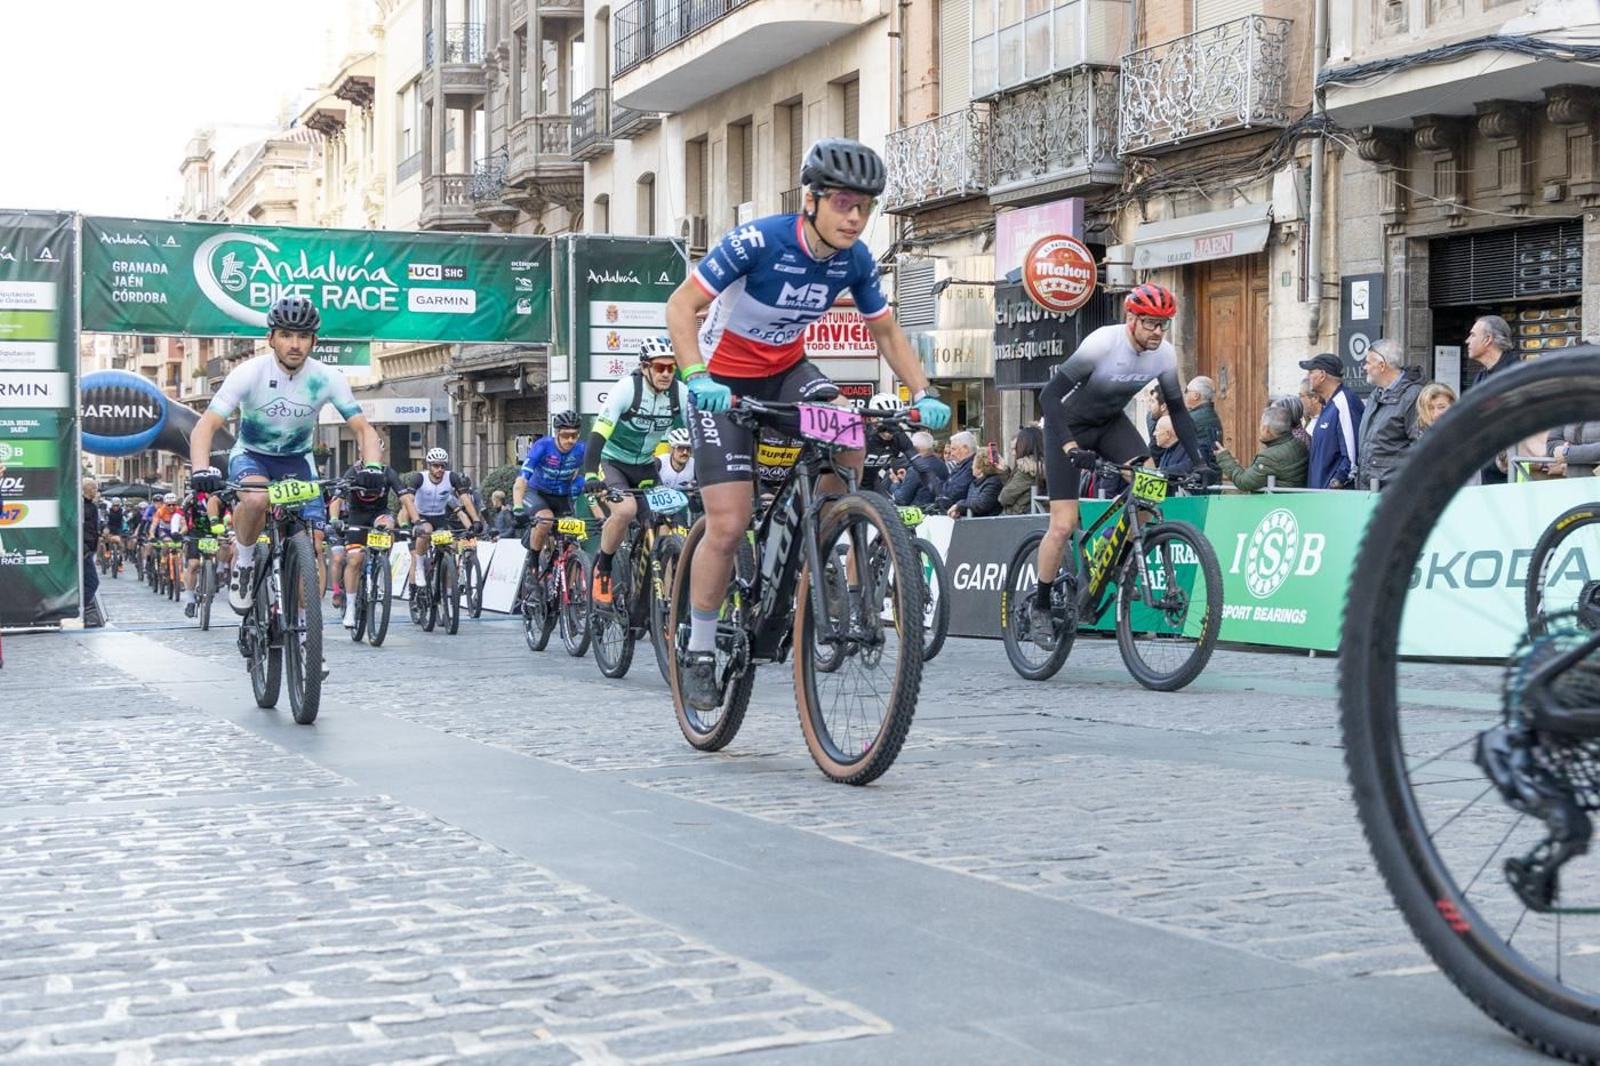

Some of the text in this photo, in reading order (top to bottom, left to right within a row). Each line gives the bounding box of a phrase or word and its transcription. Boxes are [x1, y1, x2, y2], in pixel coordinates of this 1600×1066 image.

[112, 260, 169, 274] GRANADA
[248, 247, 399, 287] Andalucía
[414, 266, 464, 278] UCI SHC
[1035, 261, 1091, 280] Mahou
[112, 273, 144, 287] JAÉN
[587, 268, 642, 285] Andalucía
[112, 289, 169, 304] CÓRDOBA
[321, 286, 400, 312] RACE
[415, 295, 469, 306] GARMIN
[311, 345, 341, 354] TAGE
[805, 342, 877, 351] TODO EN TELAS
[394, 405, 421, 414] asisa
[697, 409, 722, 448] FORT
[805, 407, 858, 441] 104-1
[273, 481, 315, 500] 318-1
[651, 492, 684, 508] 403-1
[560, 520, 584, 532] 220-1
[1253, 606, 1308, 625] BEARINGS
